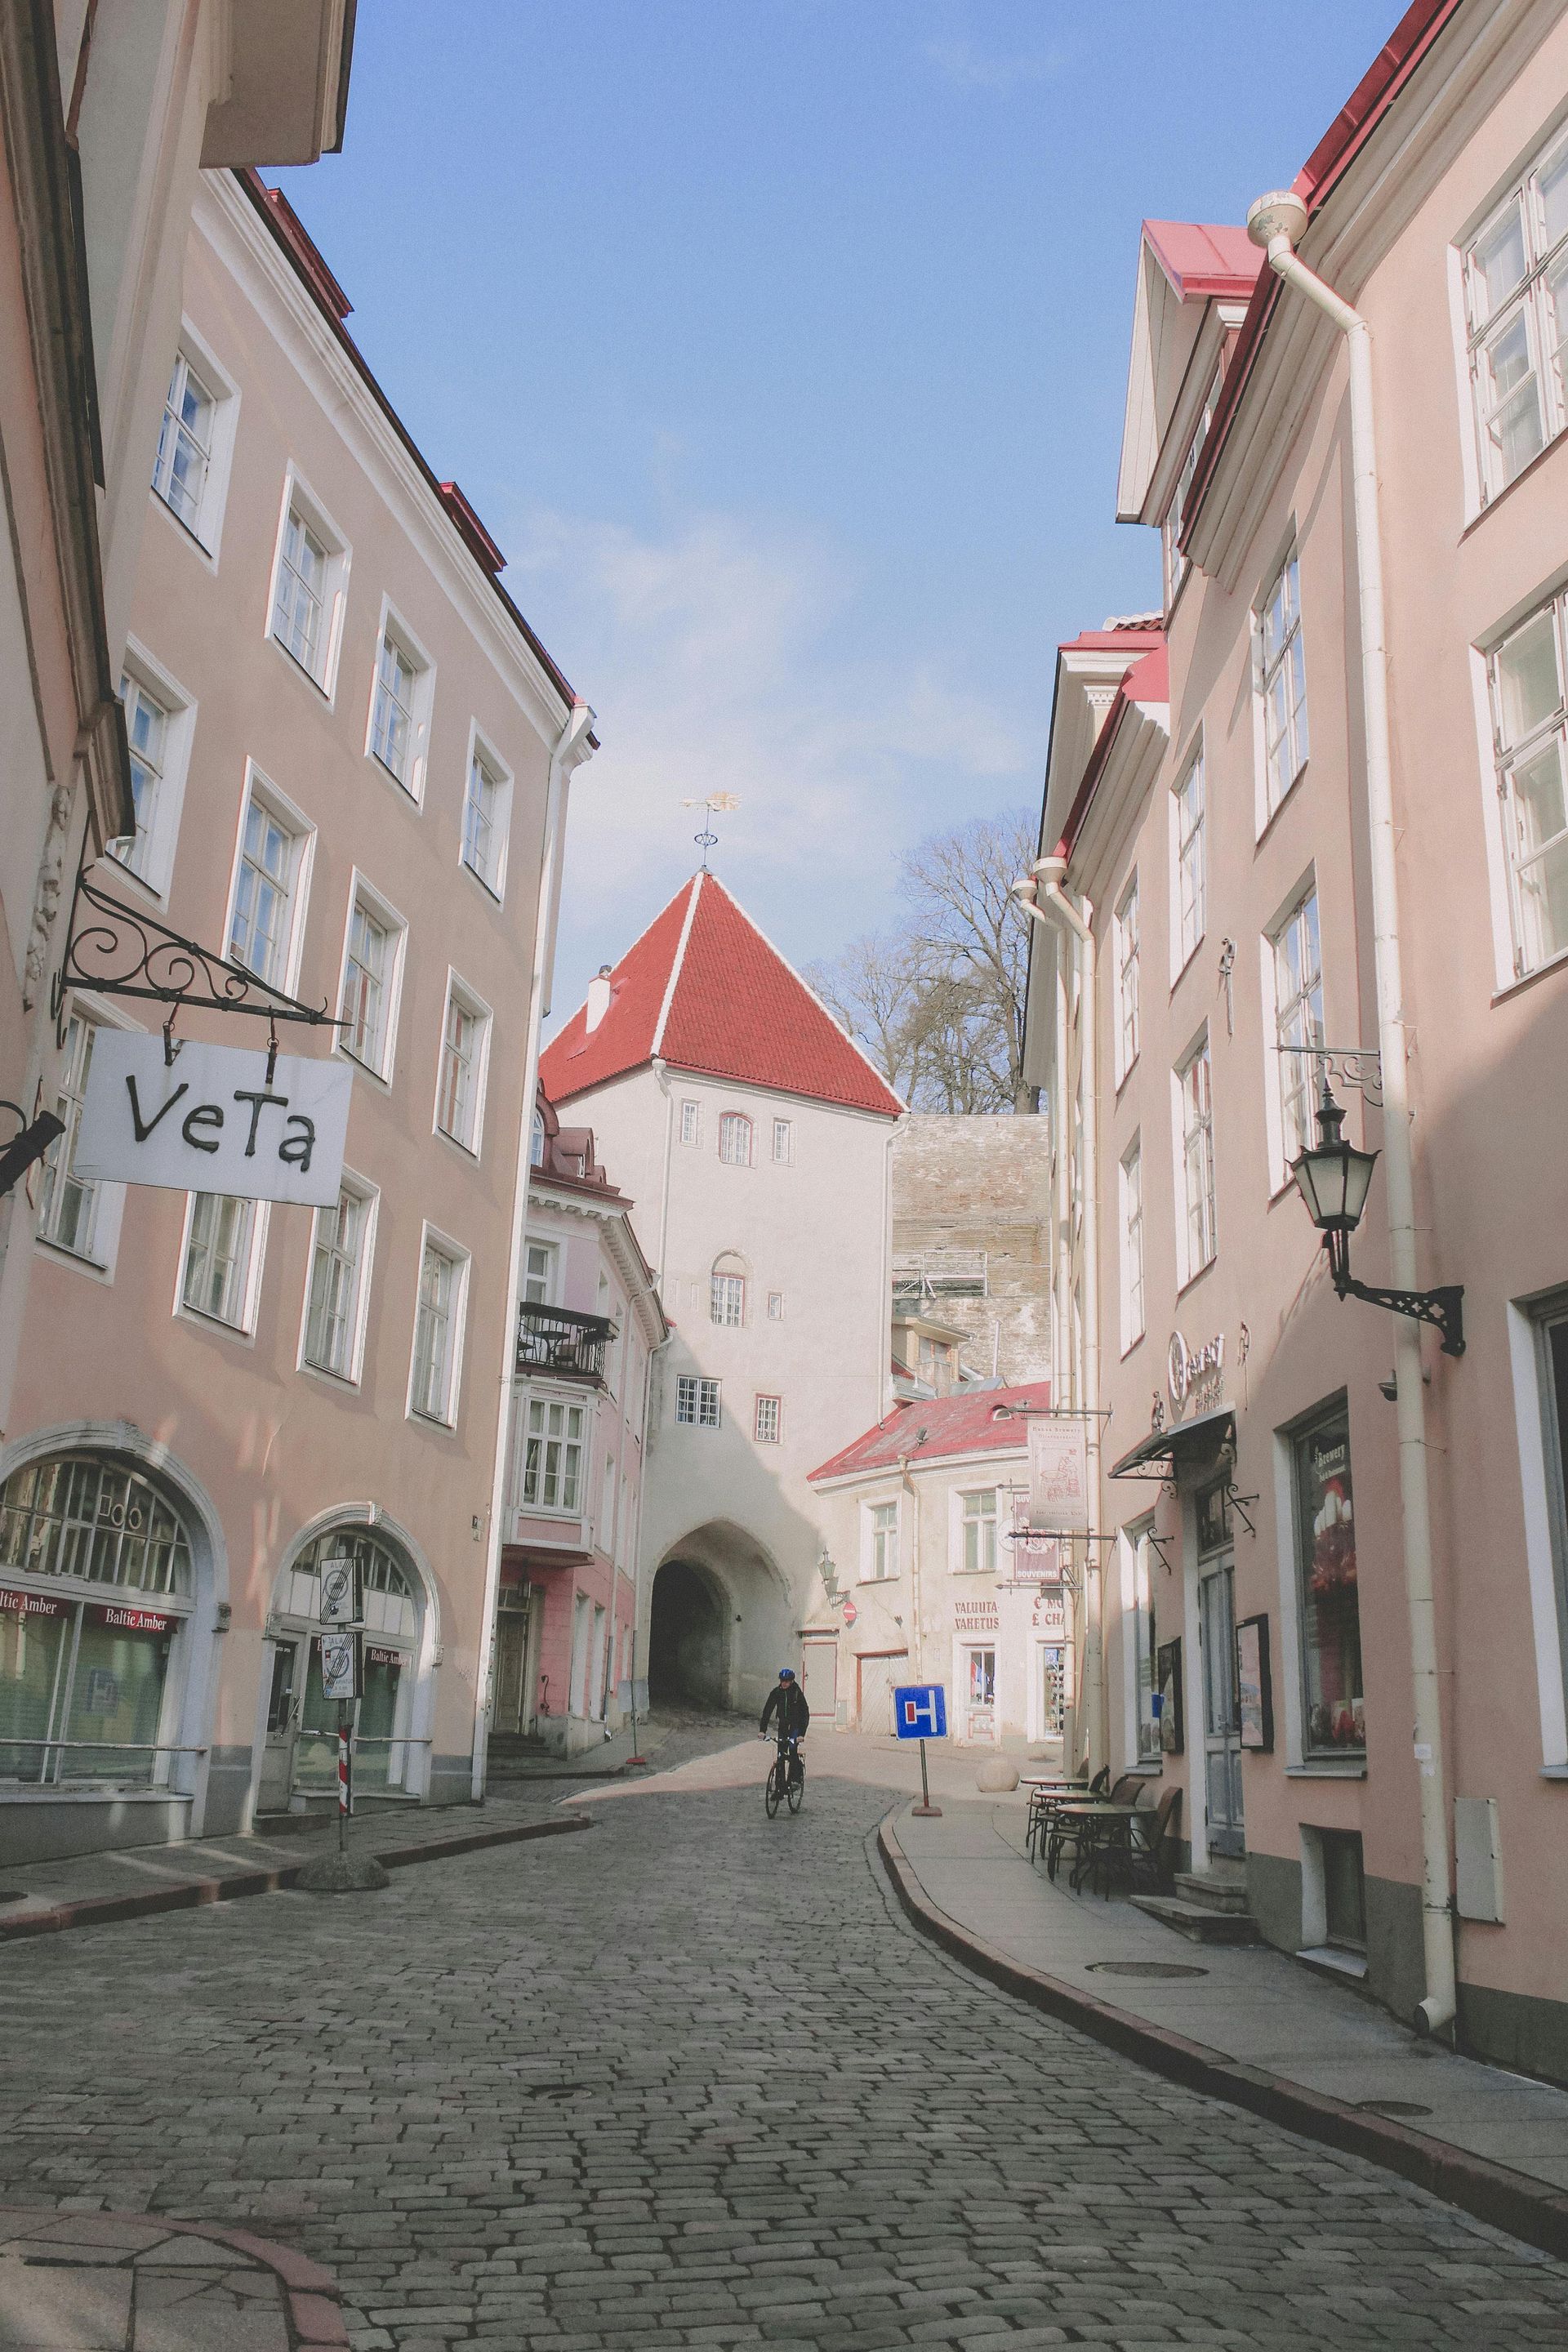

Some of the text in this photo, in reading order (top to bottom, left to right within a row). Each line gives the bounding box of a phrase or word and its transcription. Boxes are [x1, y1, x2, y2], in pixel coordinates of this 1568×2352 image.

[126, 1075, 315, 1172] VeTa
[19, 1595, 57, 1615] Amber
[105, 1608, 167, 1631] Baltic Amber
[955, 1617, 999, 1630] VAHETUS
[371, 1649, 389, 1662] Baltic
